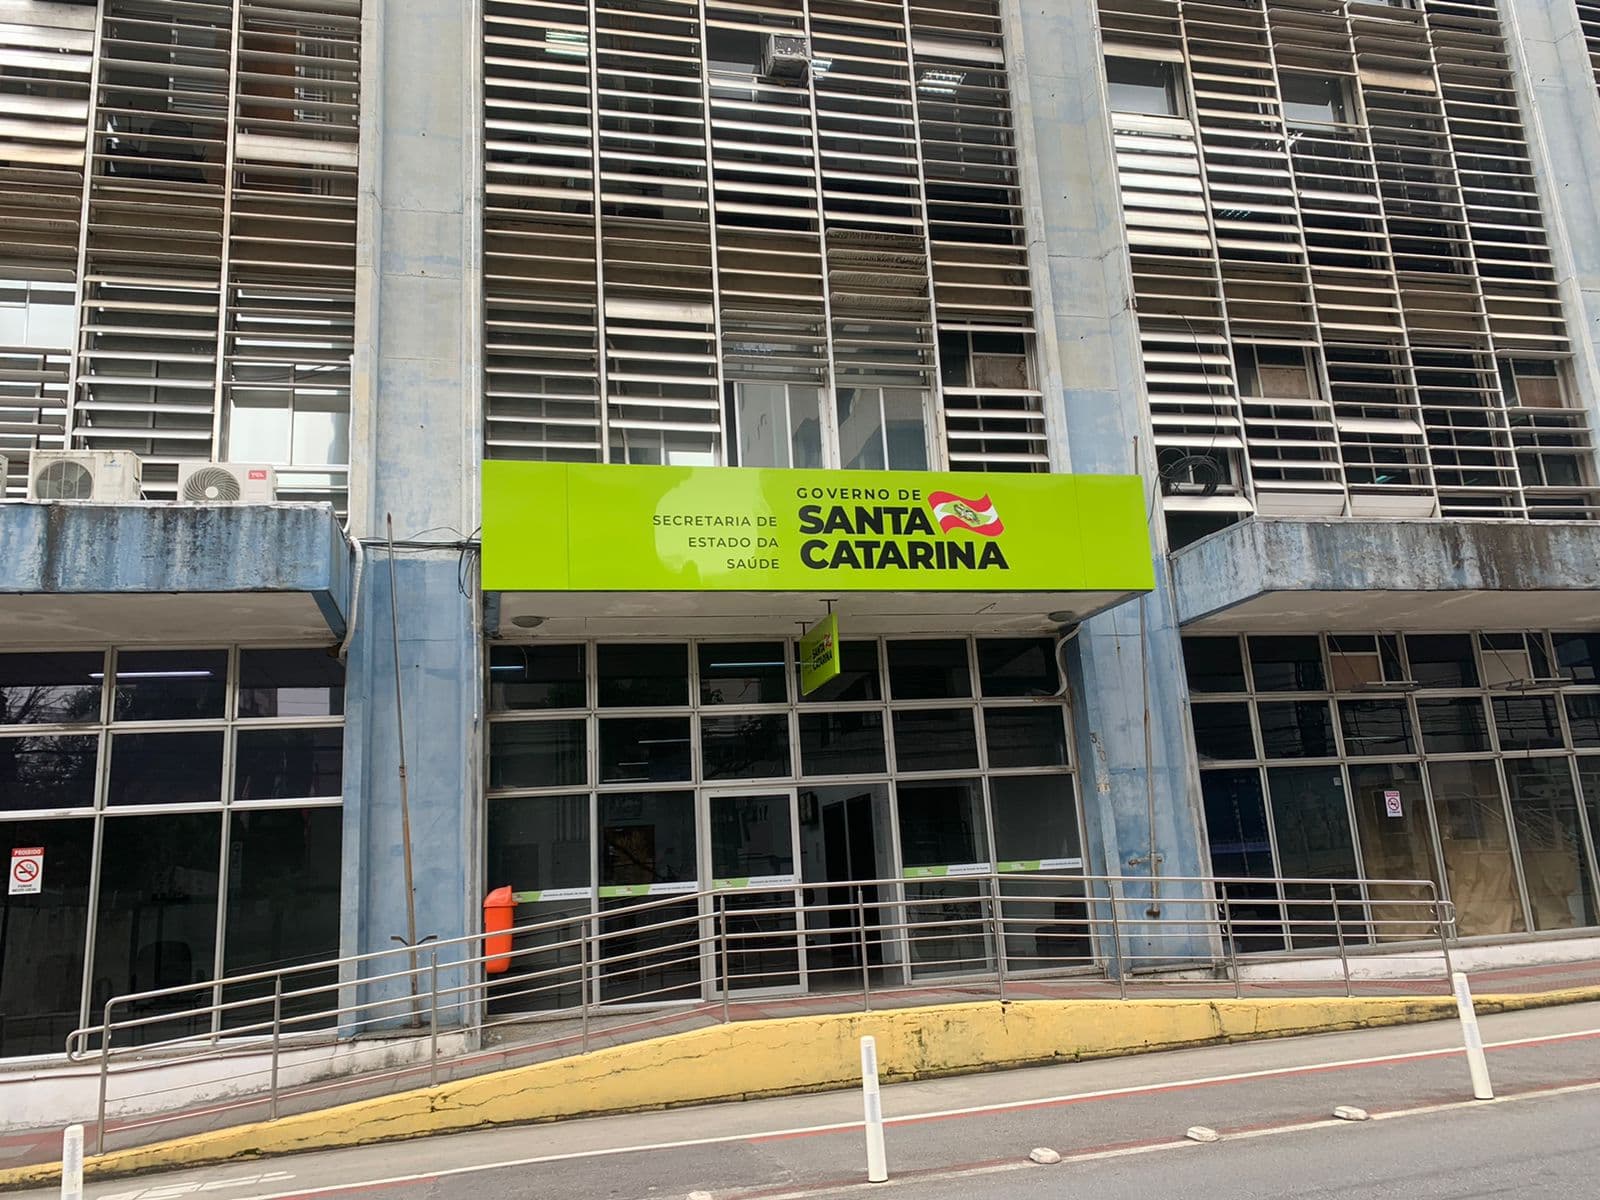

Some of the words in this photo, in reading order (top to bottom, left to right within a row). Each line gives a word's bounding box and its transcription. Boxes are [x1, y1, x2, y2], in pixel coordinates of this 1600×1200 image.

[796, 487, 890, 500] GOVERNO
[898, 489, 921, 501] DE
[652, 515, 751, 526] SECRETARIA
[757, 516, 777, 527] DE
[799, 505, 936, 535] SANTA
[688, 537, 751, 548] ESTADO
[757, 537, 779, 548] DA
[800, 539, 1010, 570] CATARINA
[726, 556, 780, 569] SAÚDE
